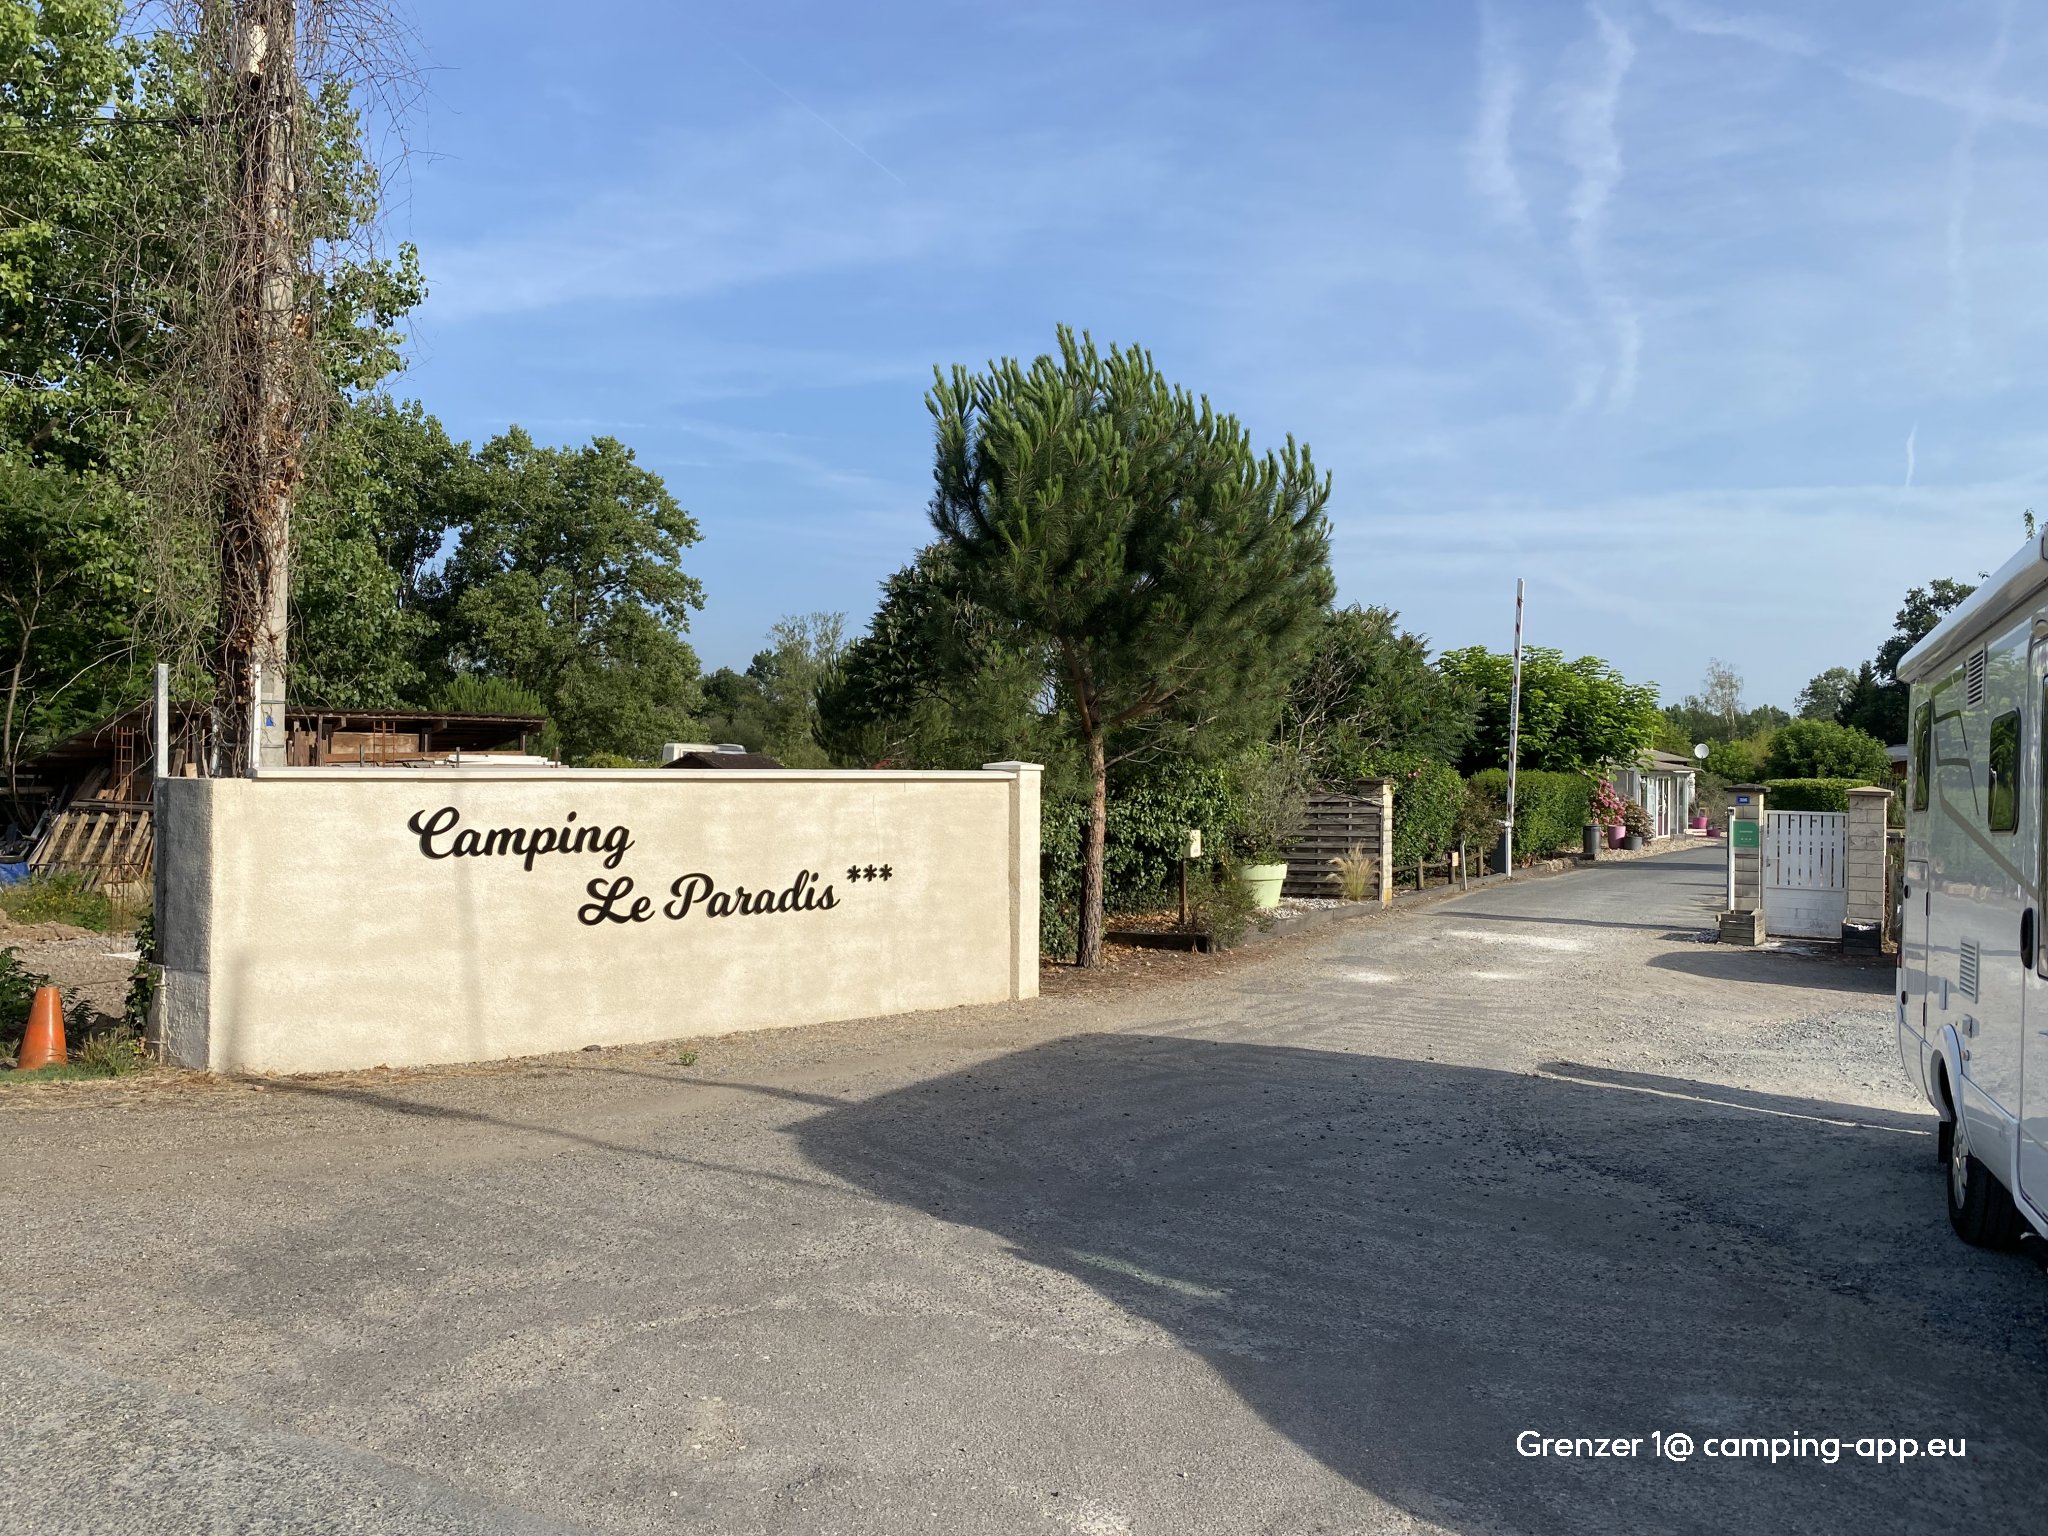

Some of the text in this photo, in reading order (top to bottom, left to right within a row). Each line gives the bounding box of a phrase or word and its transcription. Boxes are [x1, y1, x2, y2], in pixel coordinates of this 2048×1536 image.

[408, 806, 636, 872] Camping
[576, 869, 841, 926] Le Paradis
